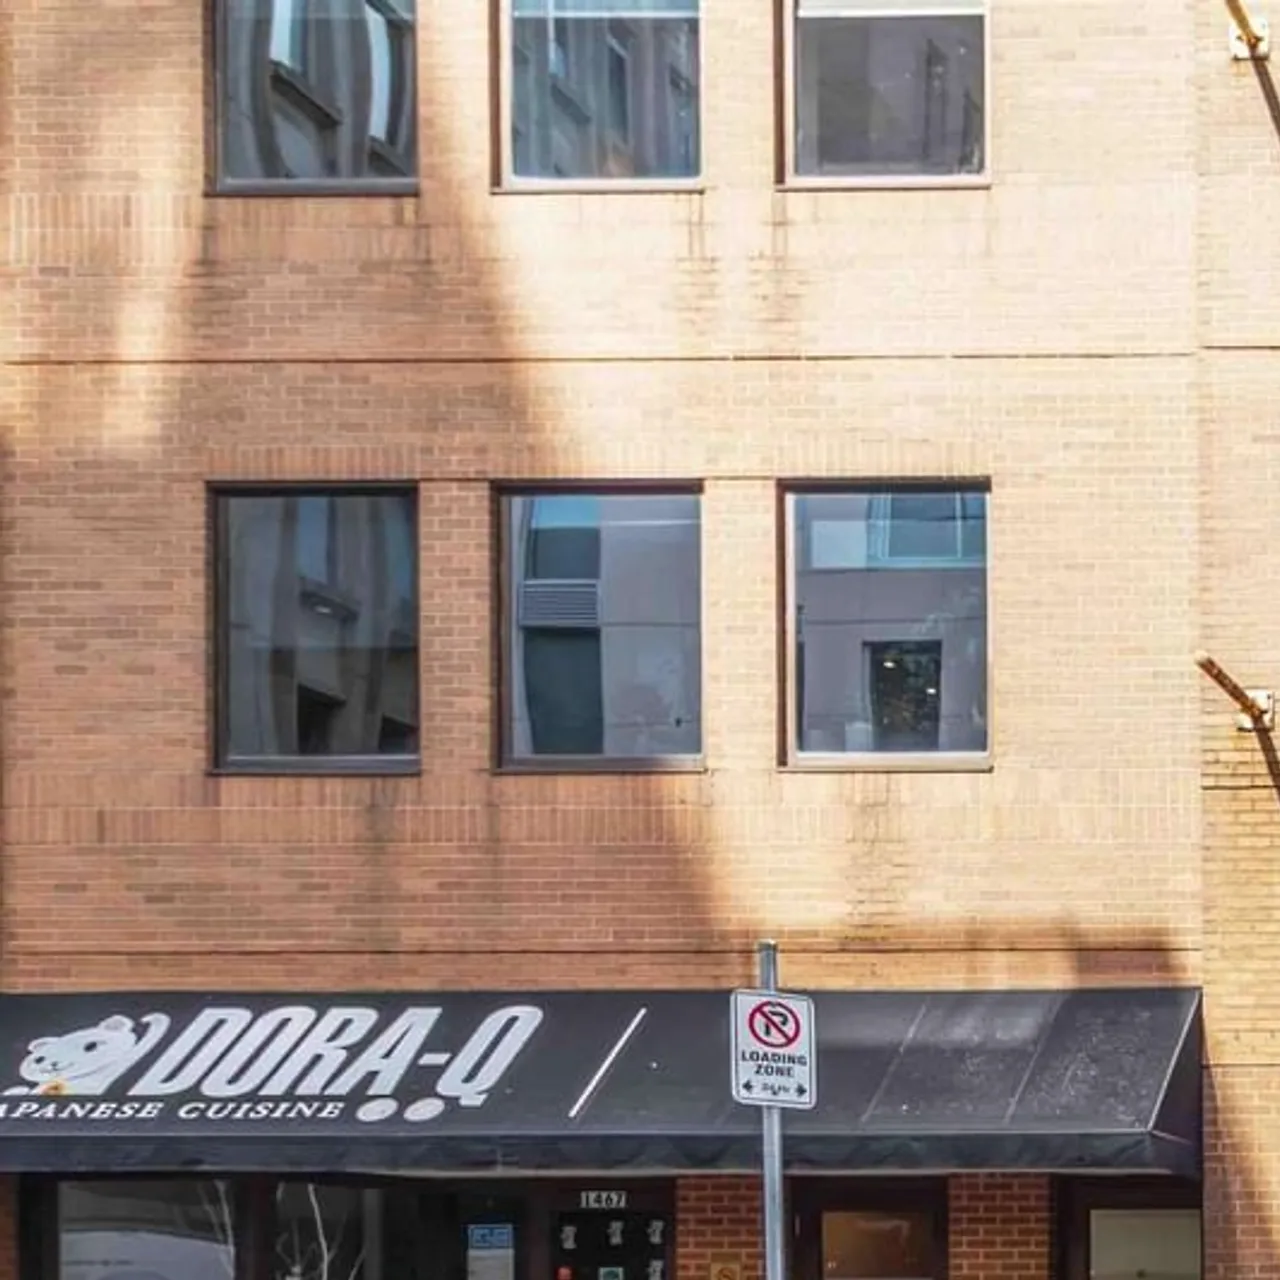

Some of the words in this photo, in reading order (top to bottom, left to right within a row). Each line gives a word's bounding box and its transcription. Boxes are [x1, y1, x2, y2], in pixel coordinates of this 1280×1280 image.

[127, 1005, 544, 1107] DORA-Q
[741, 1050, 807, 1066] LOADING
[755, 1064, 794, 1077] ZONE
[0, 1101, 163, 1120] PANESE
[178, 1101, 345, 1120] CUISINE
[580, 1190, 627, 1209] 1467
